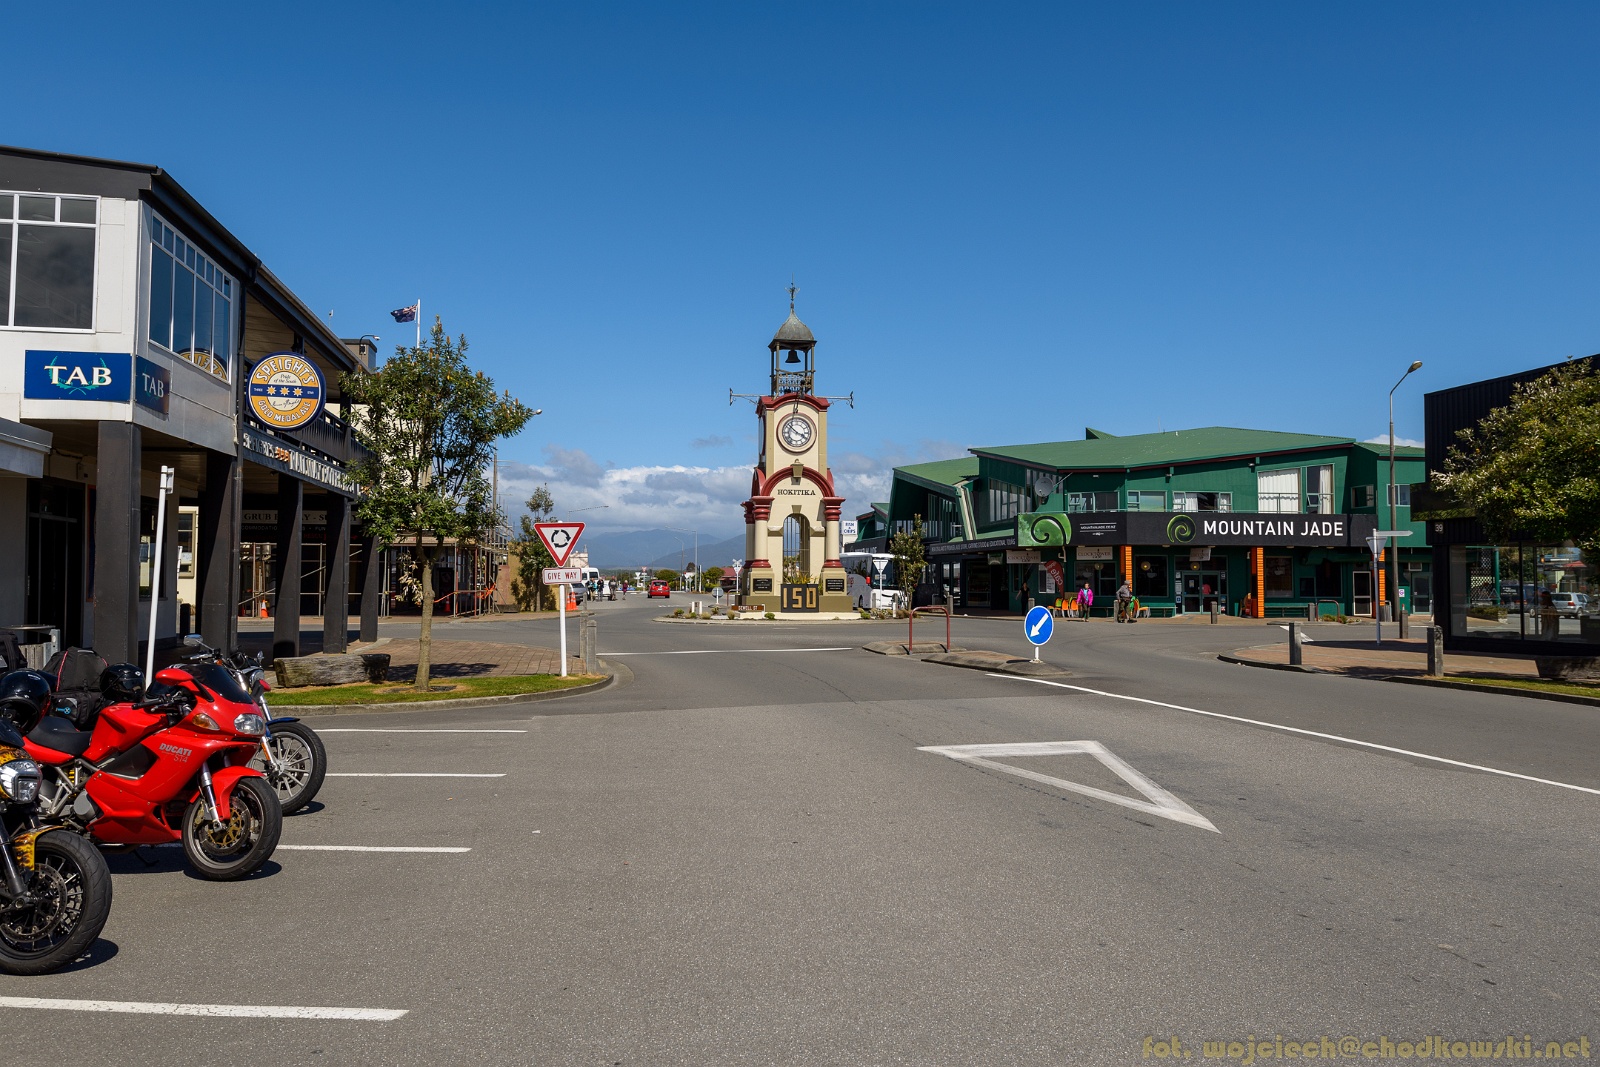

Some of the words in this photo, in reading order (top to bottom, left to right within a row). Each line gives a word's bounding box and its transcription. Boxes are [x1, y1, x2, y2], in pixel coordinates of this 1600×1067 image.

[44, 365, 112, 386] TAB
[256, 359, 314, 384] SPEIGHT'S
[142, 372, 164, 398] TAB
[258, 400, 274, 418] GOLD
[274, 413, 301, 422] MEDAL
[300, 401, 311, 416] ALE
[244, 512, 272, 520] GRUB
[1203, 520, 1294, 536] MOUNTAIN
[1300, 521, 1344, 537] JADE
[1434, 523, 1444, 532] 39
[783, 587, 817, 609] 150
[159, 743, 192, 756] DUCATI
